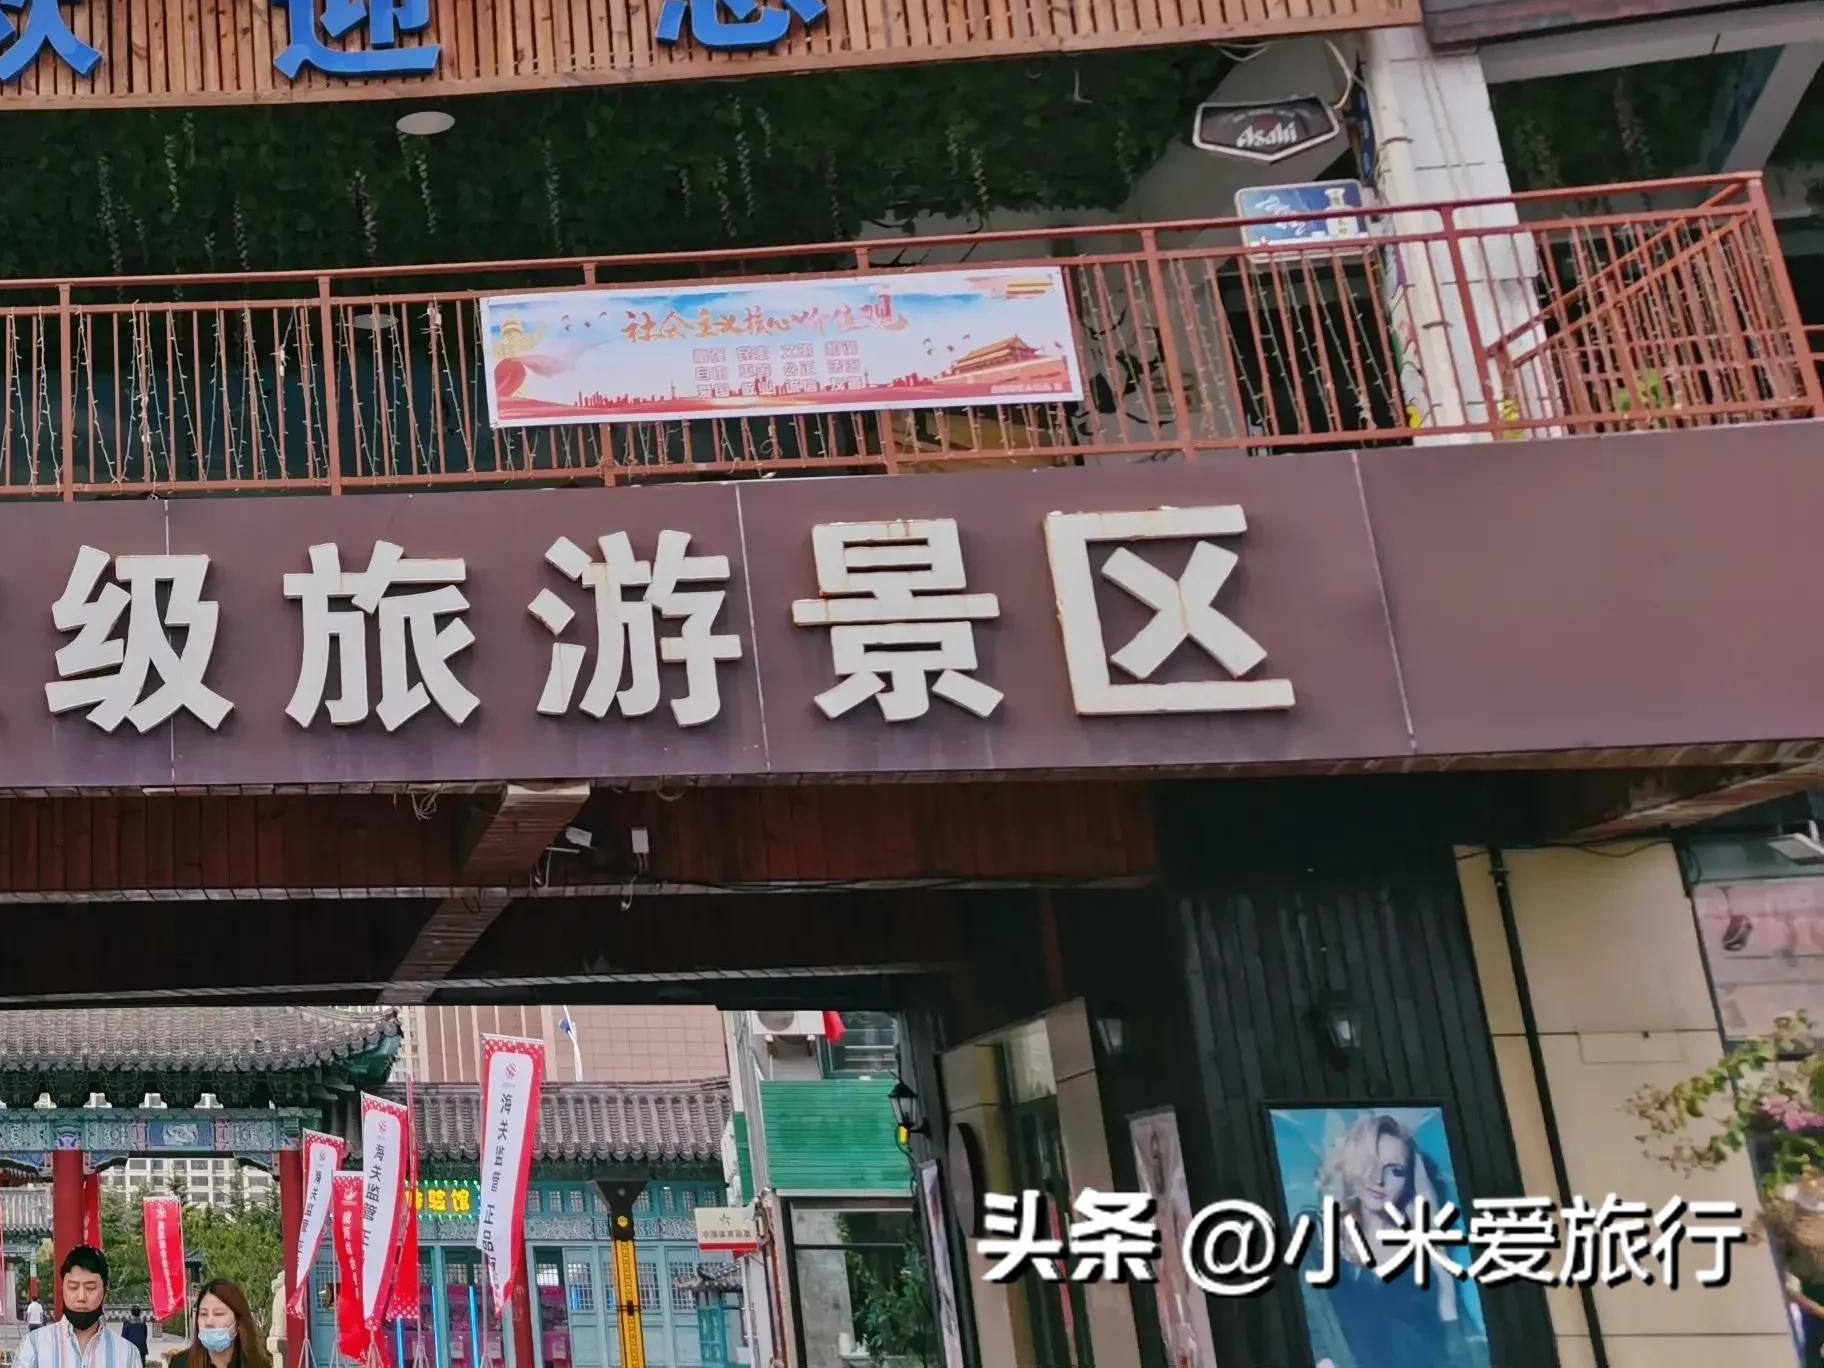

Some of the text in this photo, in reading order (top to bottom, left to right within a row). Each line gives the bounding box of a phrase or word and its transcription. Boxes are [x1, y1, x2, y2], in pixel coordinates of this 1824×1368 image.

[1236, 122, 1298, 148] Asahi
[622, 294, 909, 343] 社会主义核心价值观
